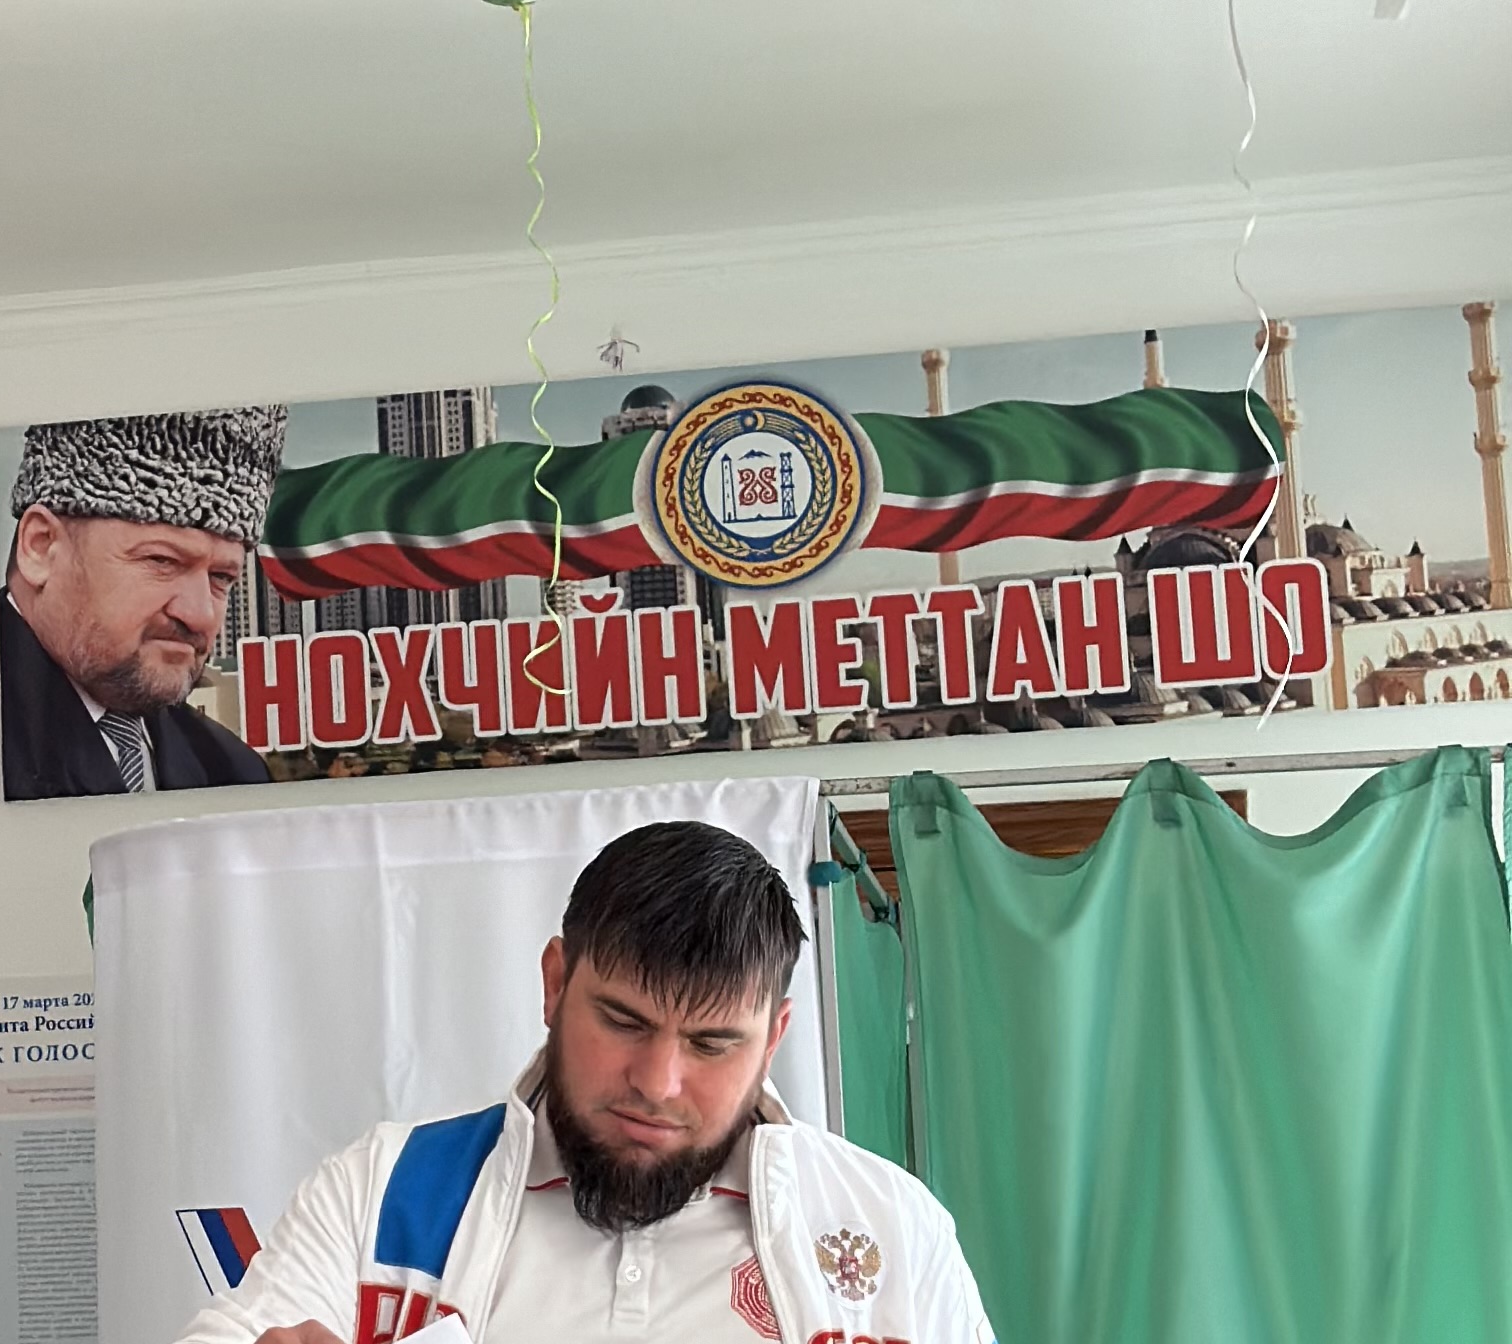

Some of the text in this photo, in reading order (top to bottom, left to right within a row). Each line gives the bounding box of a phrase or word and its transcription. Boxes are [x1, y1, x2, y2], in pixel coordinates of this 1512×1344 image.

[238, 558, 1332, 751] НОХЧИЙН МЕТТАН ШО
[3, 996, 19, 1010] 17
[23, 995, 69, 1011] марта
[13, 1042, 96, 1063] ГОЛОС
